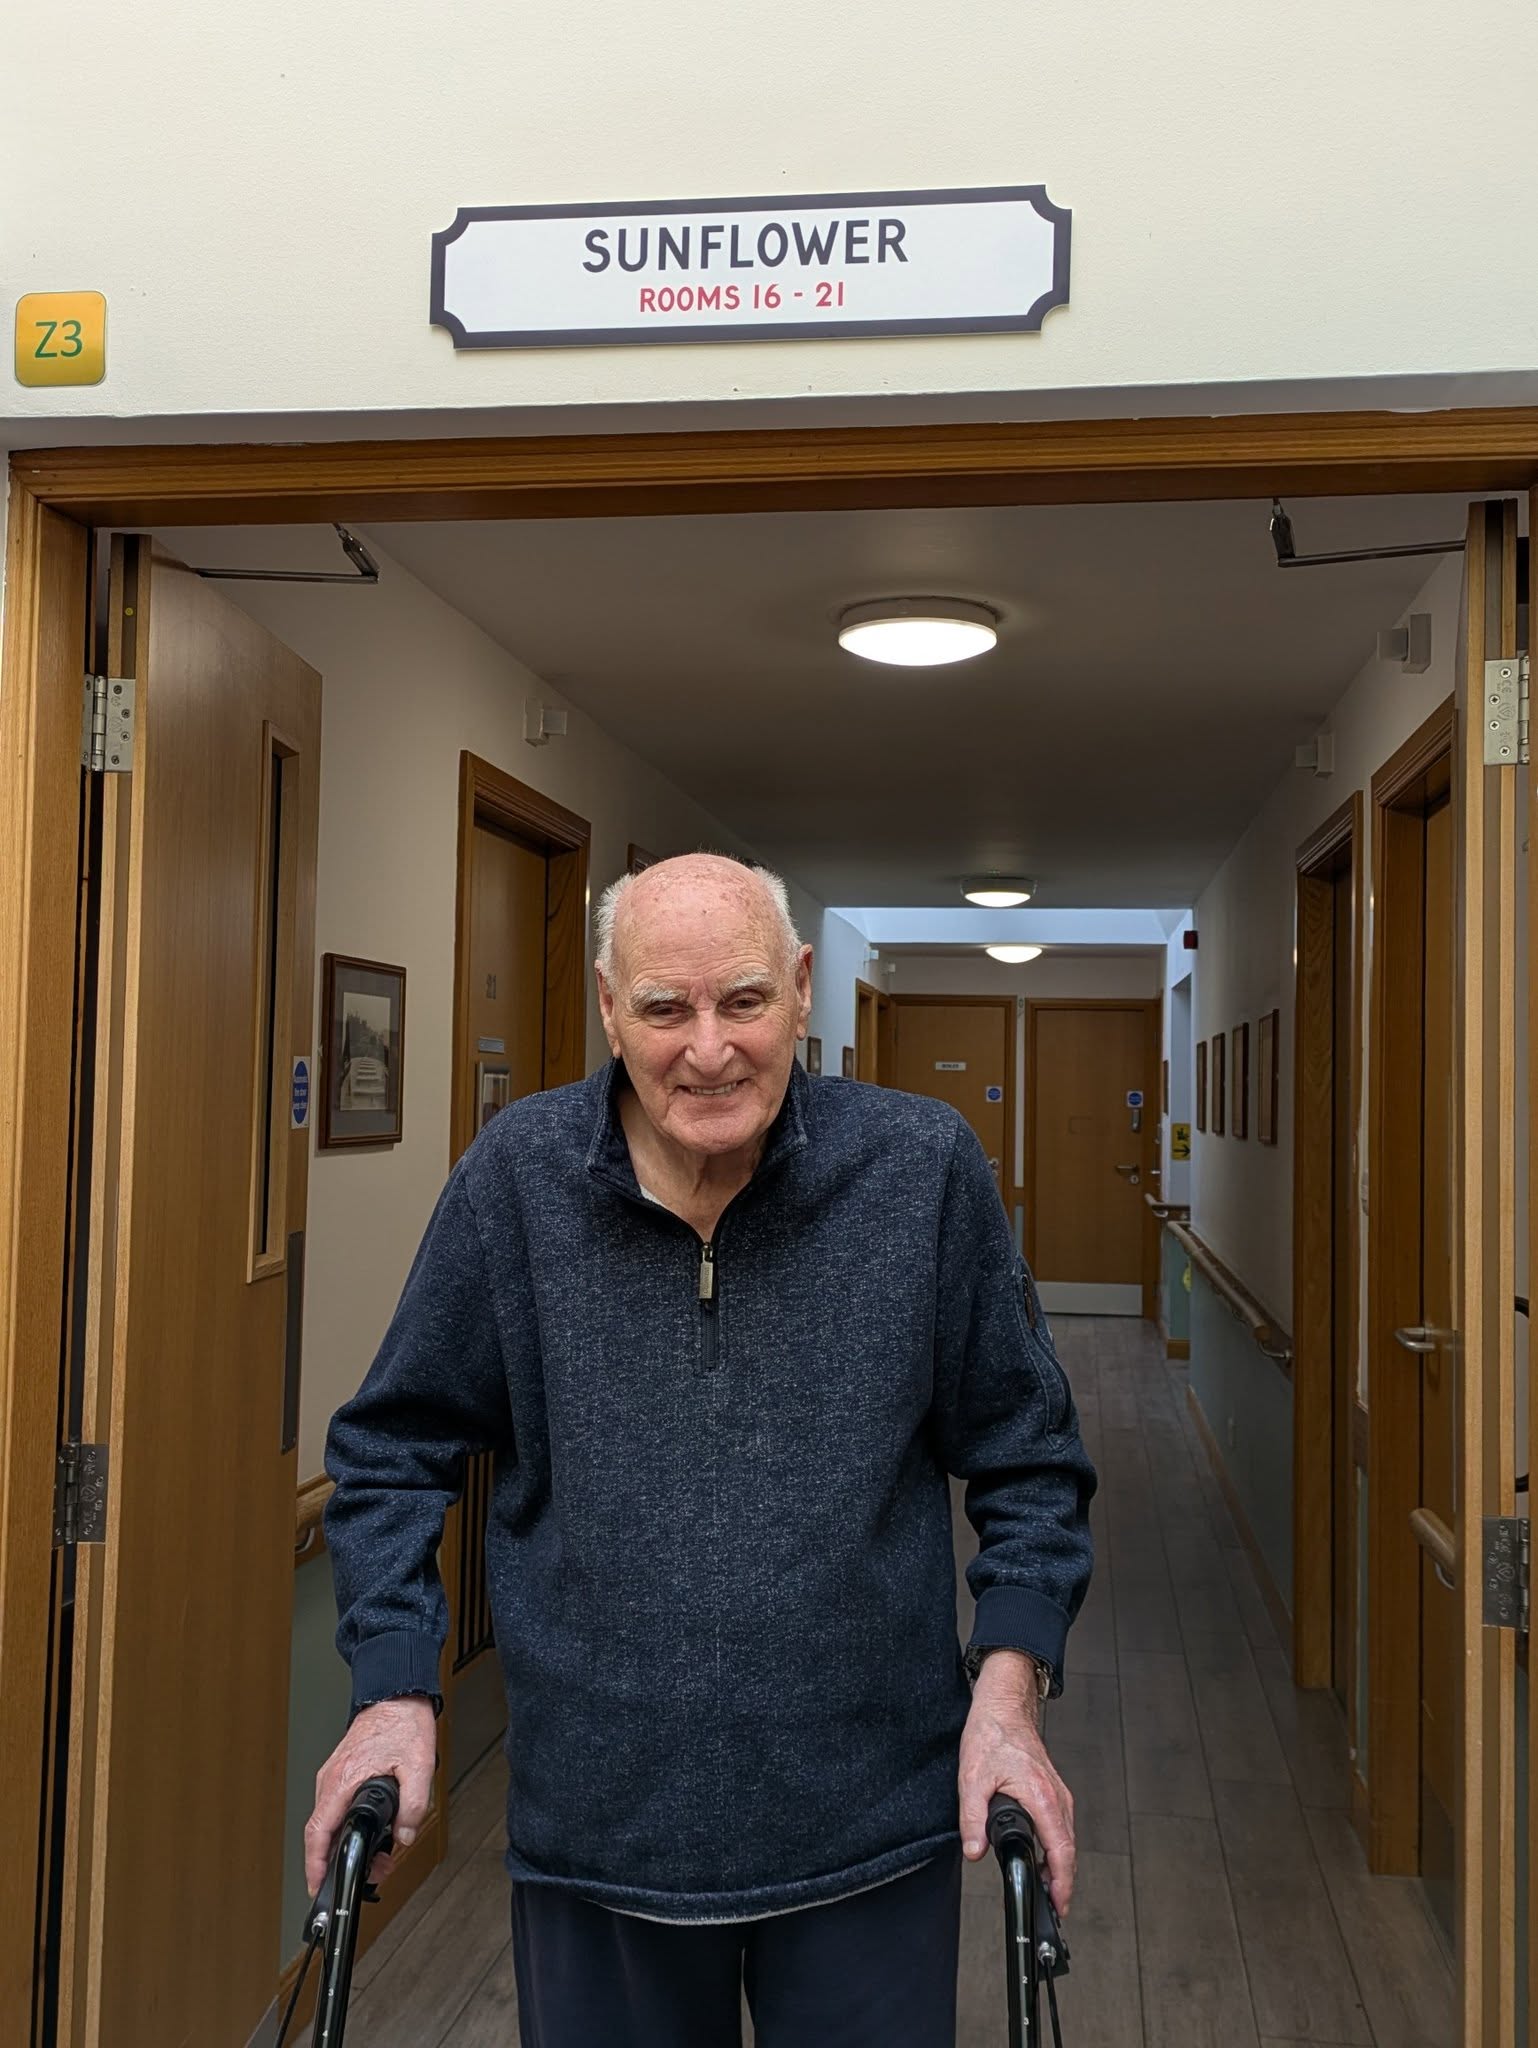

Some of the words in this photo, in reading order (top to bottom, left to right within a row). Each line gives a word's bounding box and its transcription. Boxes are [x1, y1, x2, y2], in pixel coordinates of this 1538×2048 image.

[583, 219, 908, 273] SUNFLOWER
[641, 284, 739, 312] ROOMS
[754, 283, 780, 309] 16
[816, 281, 844, 307] 21
[35, 320, 83, 359] Z3
[336, 1908, 349, 1916] Min
[1016, 1935, 1030, 1943] Min
[334, 1948, 340, 1956] 2
[1022, 1976, 1028, 1984] 2
[328, 1988, 334, 1997] 3
[1023, 2017, 1029, 2025] 3
